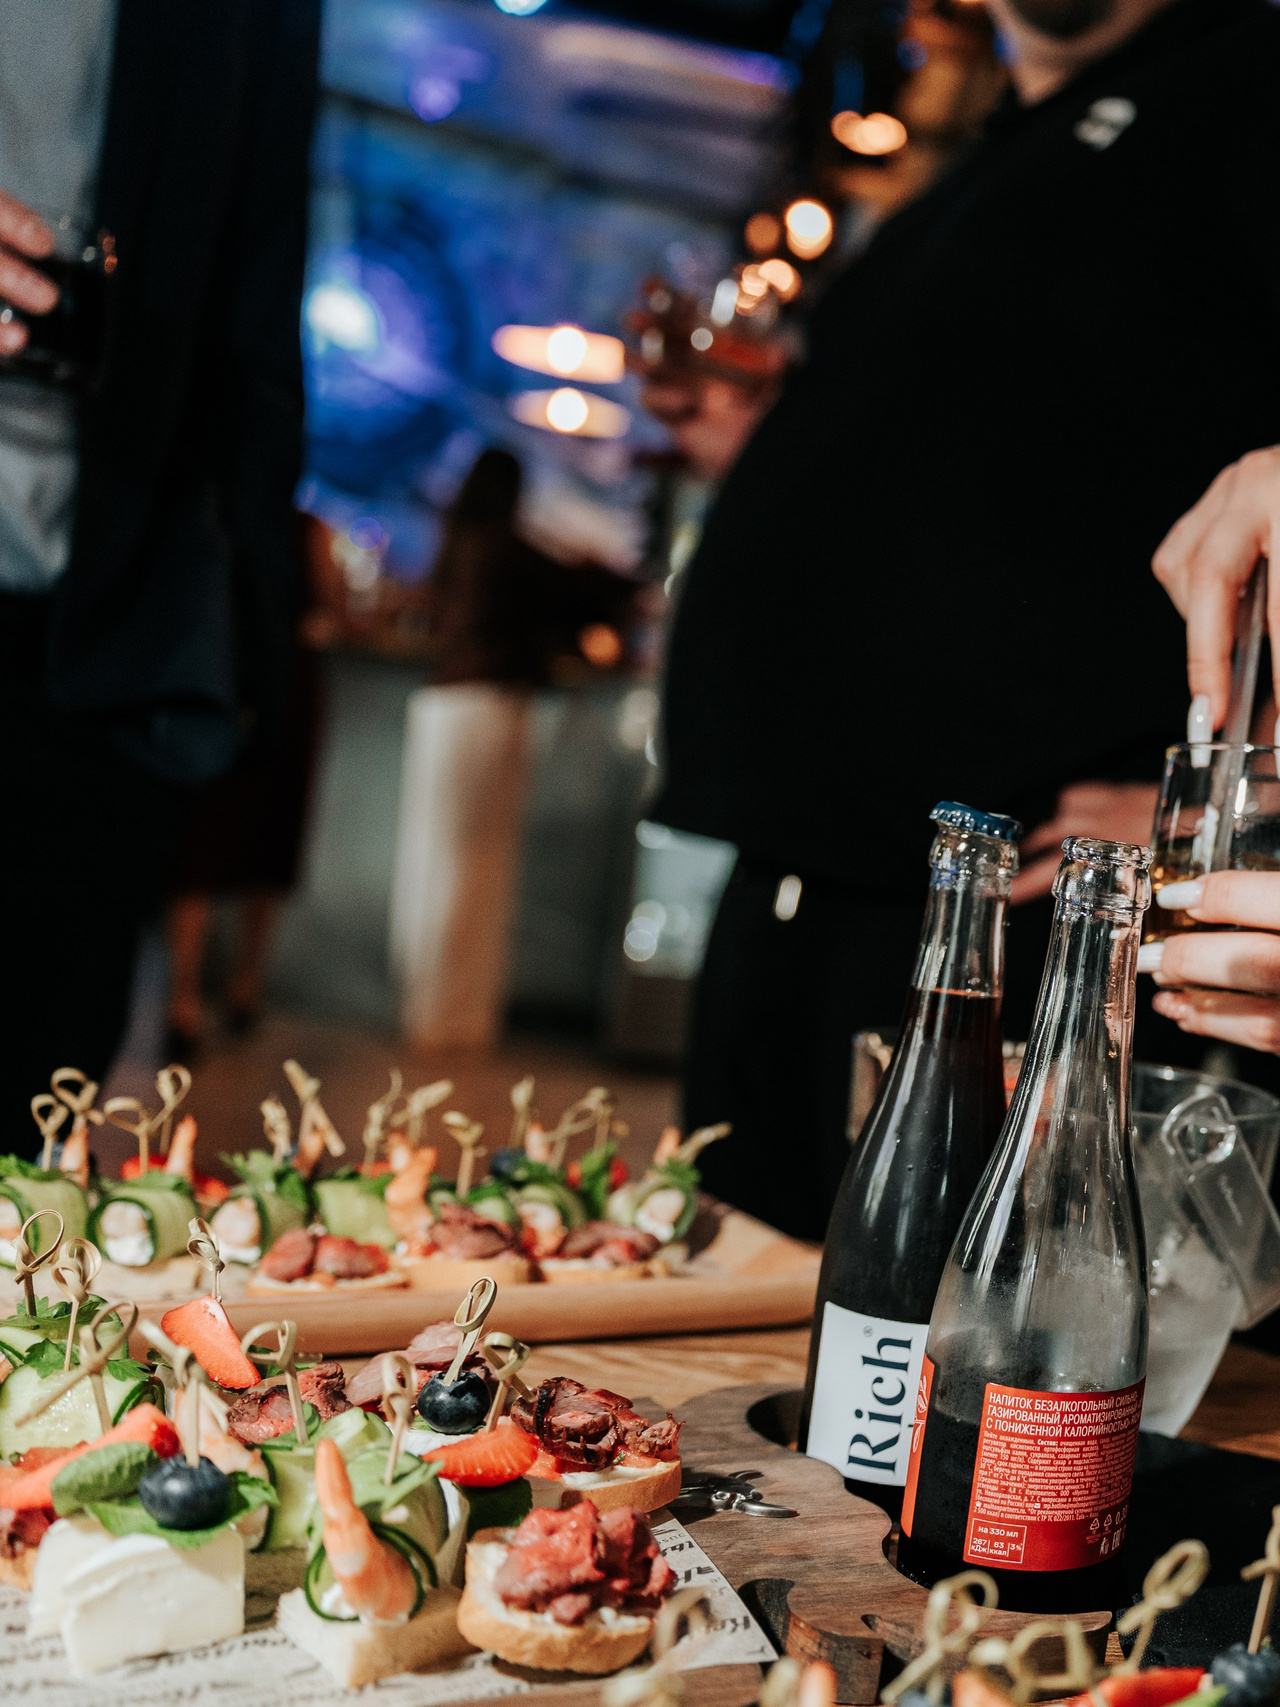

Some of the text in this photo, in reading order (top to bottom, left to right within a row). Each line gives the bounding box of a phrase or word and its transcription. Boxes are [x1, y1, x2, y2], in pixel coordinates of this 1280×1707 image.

[845, 1336, 913, 1476] Rich
[989, 1392, 1033, 1409] НАПИТОК
[1034, 1397, 1115, 1412] БЕЗАЛКОГОЛЬНЫЙ
[987, 1403, 1061, 1424] ГАЗИРОВАННЫЙ
[986, 1417, 993, 1429] С
[995, 1418, 1063, 1437] ПОНИЖЕННОЙ
[979, 1526, 988, 1534] на
[990, 1528, 1005, 1536] 330
[973, 1537, 987, 1546] 267
[994, 1541, 1004, 1549] 63
[990, 1548, 1007, 1556] ккал
